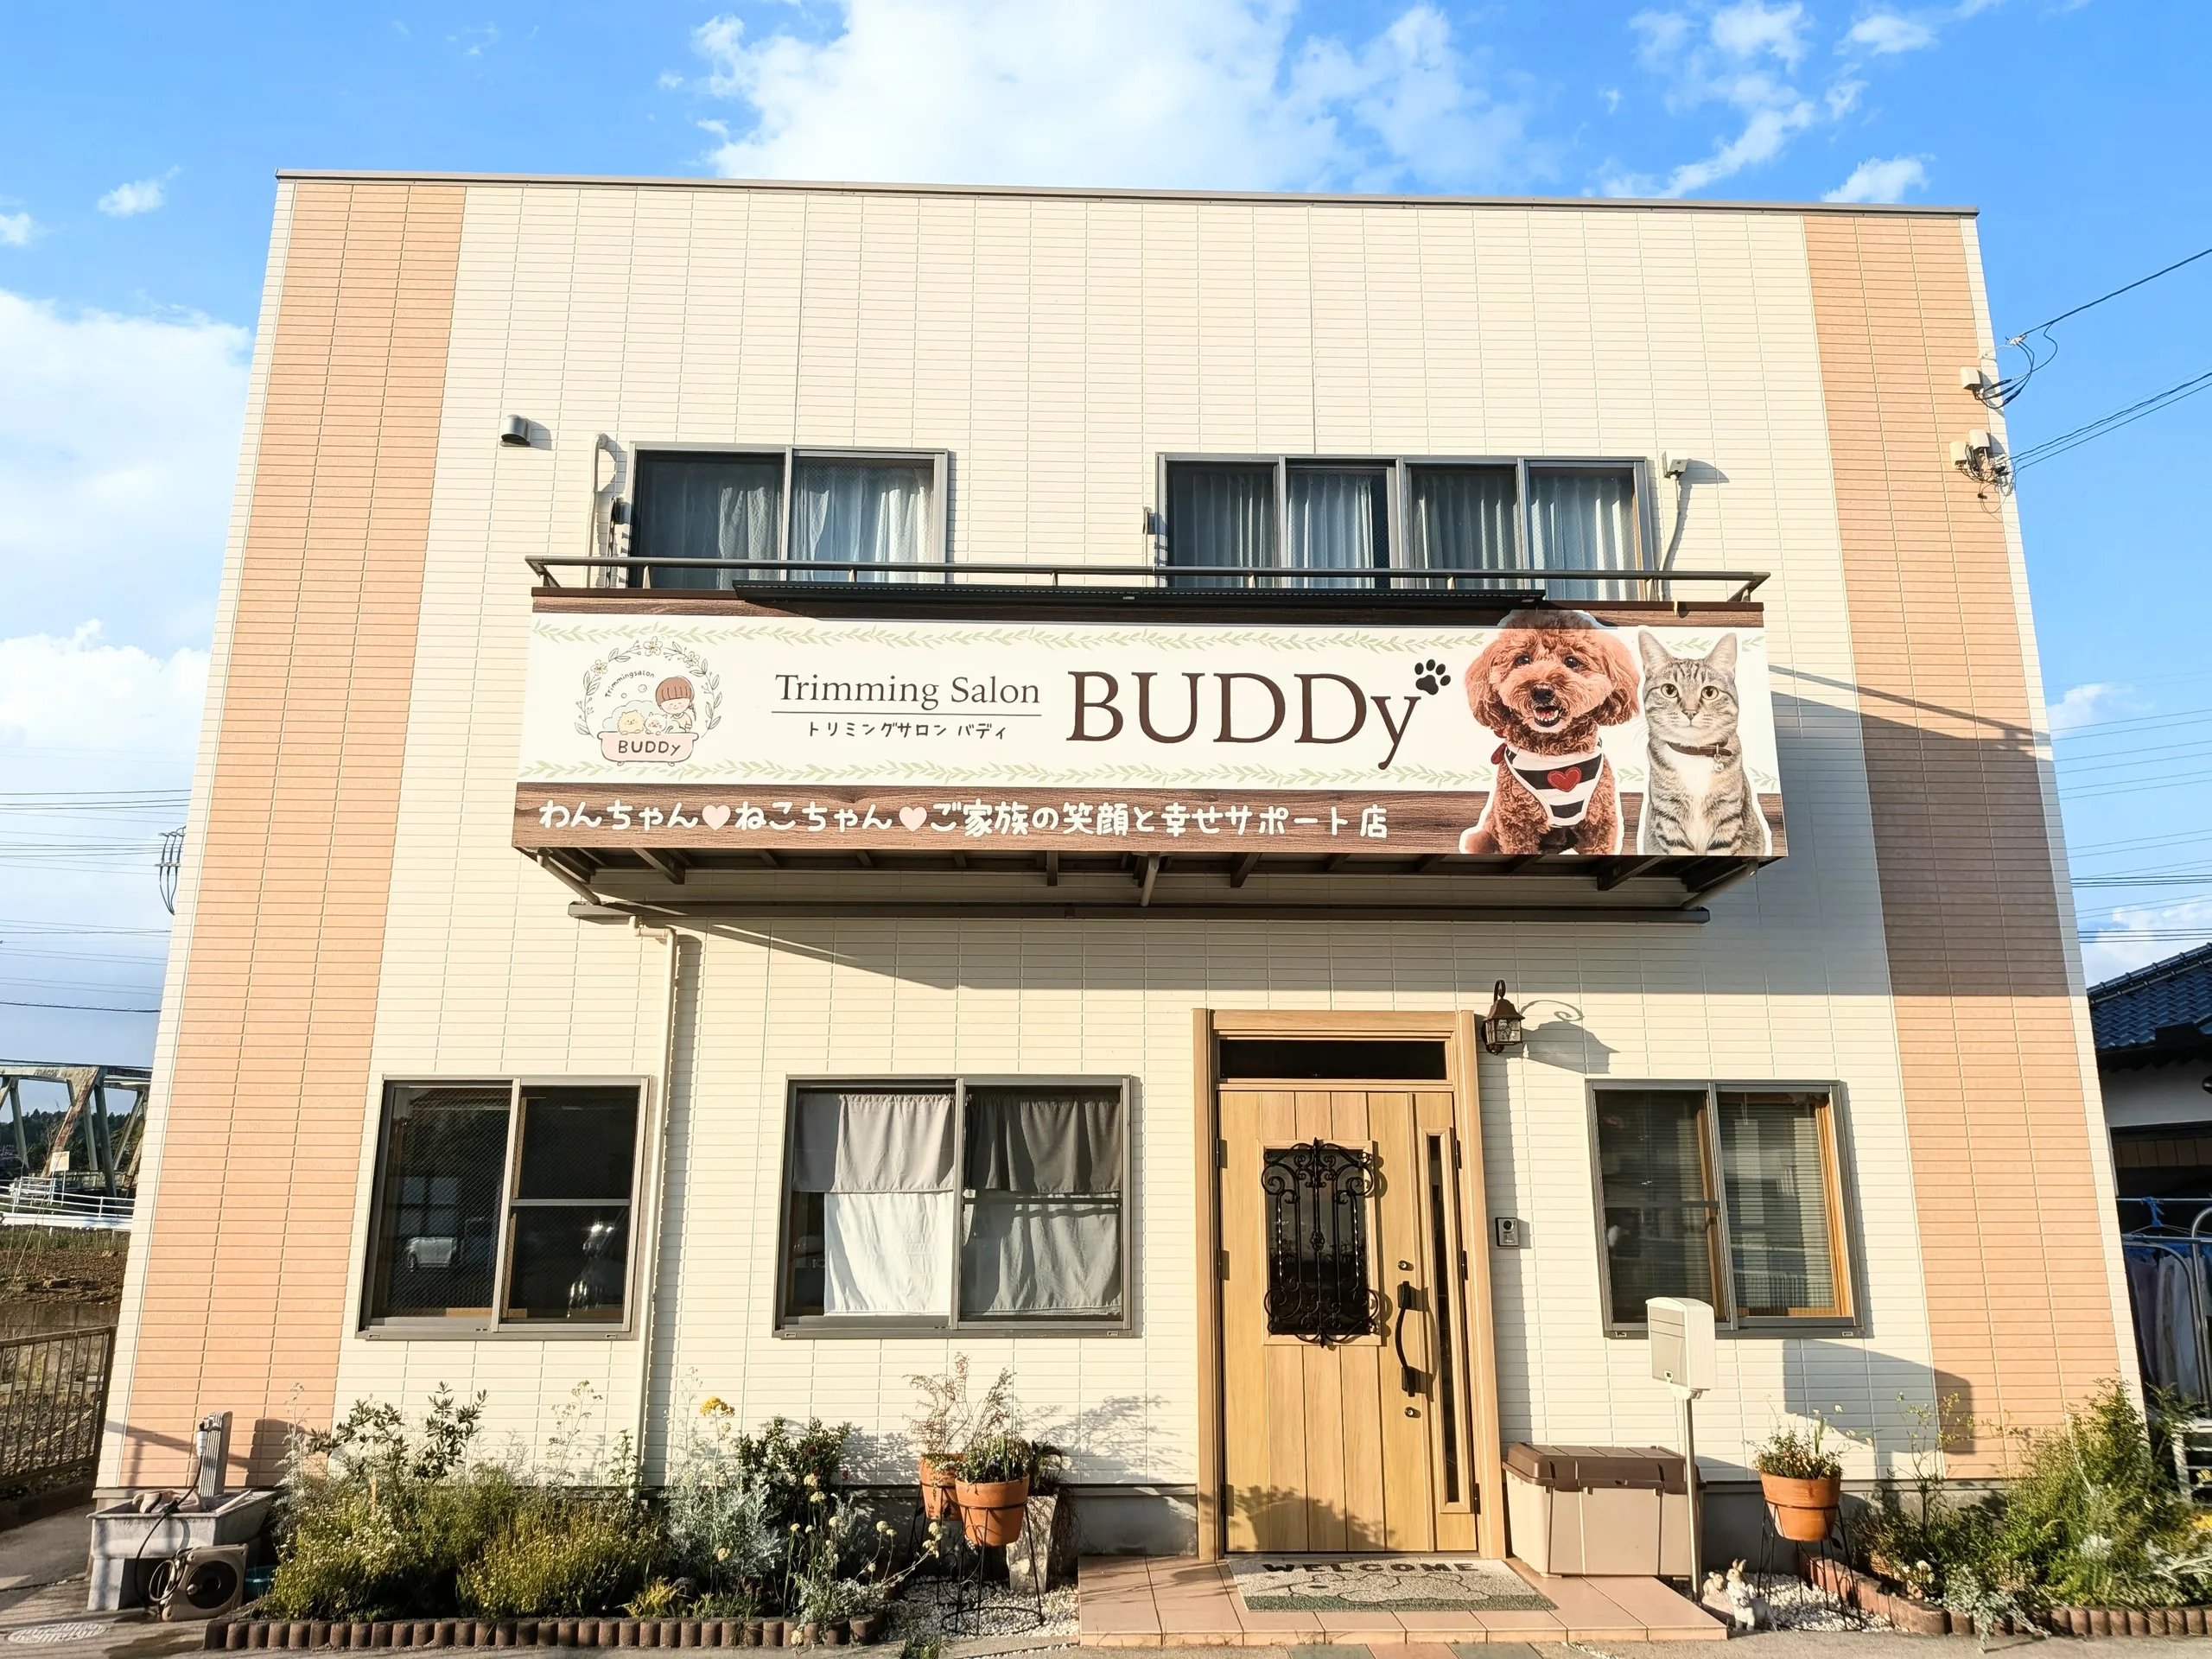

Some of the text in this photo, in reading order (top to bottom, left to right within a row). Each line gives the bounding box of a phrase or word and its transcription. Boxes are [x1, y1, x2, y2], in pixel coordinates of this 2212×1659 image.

[605, 670, 655, 697] Trimmingsalon
[775, 673, 1040, 711] Trimming Salon
[810, 721, 1007, 741] トリミングサロン バディ
[538, 798, 698, 831] わんちゃん
[734, 800, 893, 833] ねこちゃん
[1262, 1562, 1479, 1573] WELCOME
